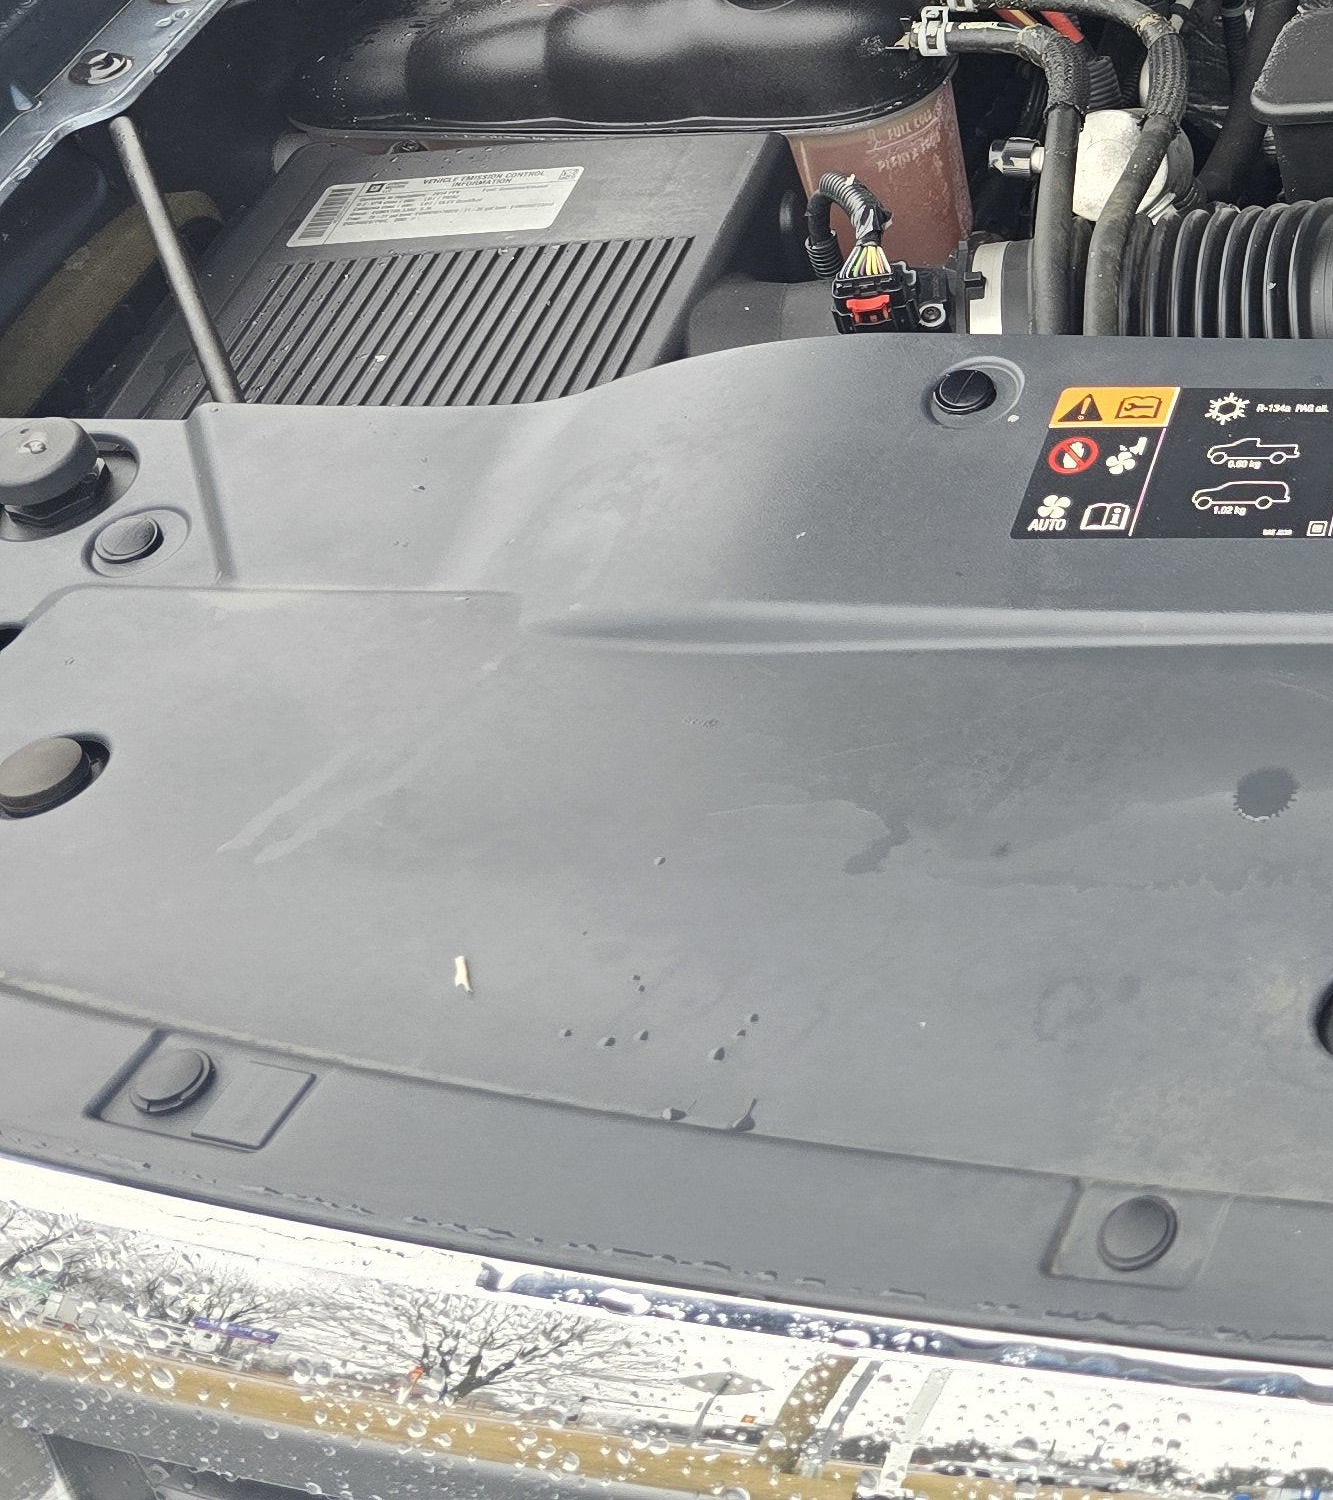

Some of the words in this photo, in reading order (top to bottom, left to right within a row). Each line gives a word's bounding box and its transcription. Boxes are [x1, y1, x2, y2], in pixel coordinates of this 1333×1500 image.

[423, 177, 457, 185] VEHICLE
[461, 173, 503, 182] EMISSION
[505, 170, 545, 179] CONTROL
[452, 178, 512, 187] INFORMATION
[1249, 460, 1262, 470] kg
[1213, 506, 1234, 515] 1.02
[1233, 506, 1247, 516] kg
[1027, 518, 1067, 532] AUTO
